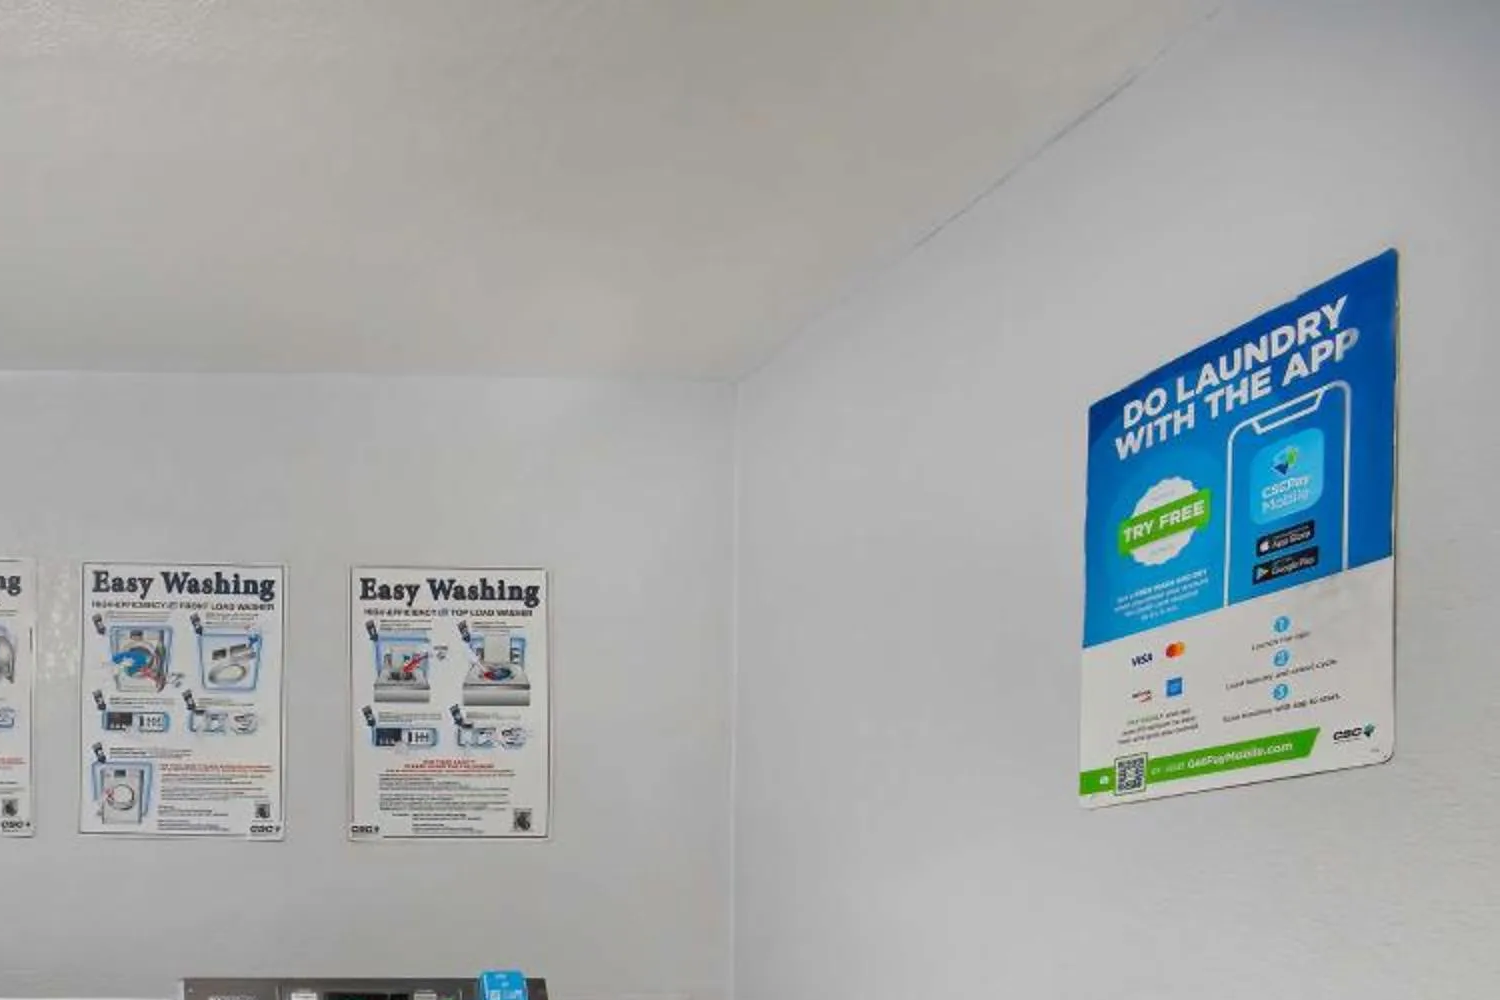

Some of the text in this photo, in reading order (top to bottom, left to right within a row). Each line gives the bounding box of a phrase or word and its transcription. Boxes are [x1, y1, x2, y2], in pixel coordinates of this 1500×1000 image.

[1123, 295, 1348, 429] DO LAUNDRY
[1115, 327, 1360, 461] WITH THE APP
[1123, 499, 1206, 544] TRY FREE
[92, 570, 276, 602] Easy Washing
[359, 577, 541, 609] Easy Washing
[1131, 652, 1153, 666] VISA
